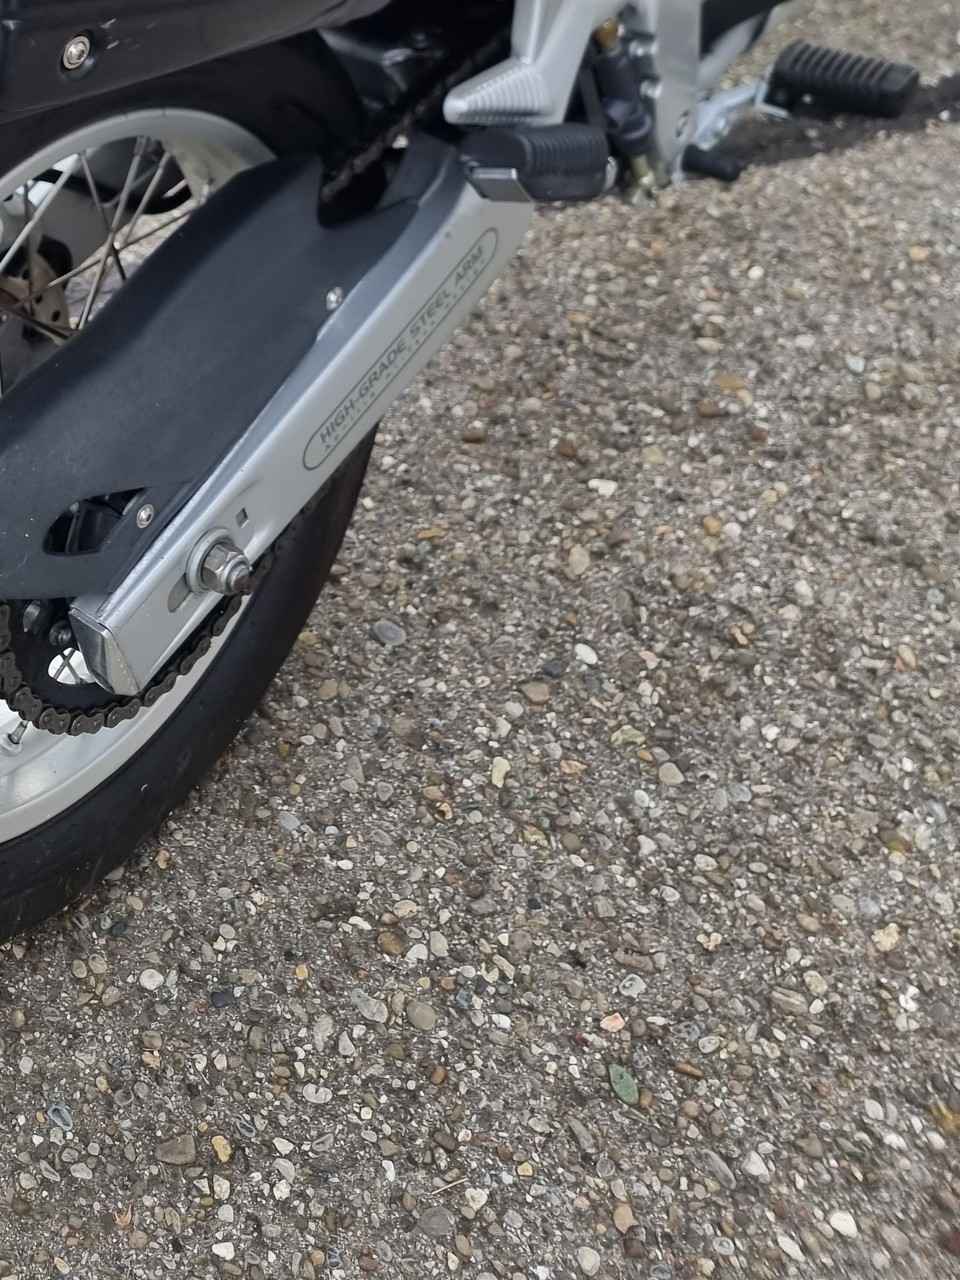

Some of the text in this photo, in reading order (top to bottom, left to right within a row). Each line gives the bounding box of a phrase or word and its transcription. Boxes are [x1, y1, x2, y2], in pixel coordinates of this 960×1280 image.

[319, 338, 406, 444] HIGH-GRADE
[409, 288, 451, 336] STEEL
[454, 245, 483, 283] ARM
